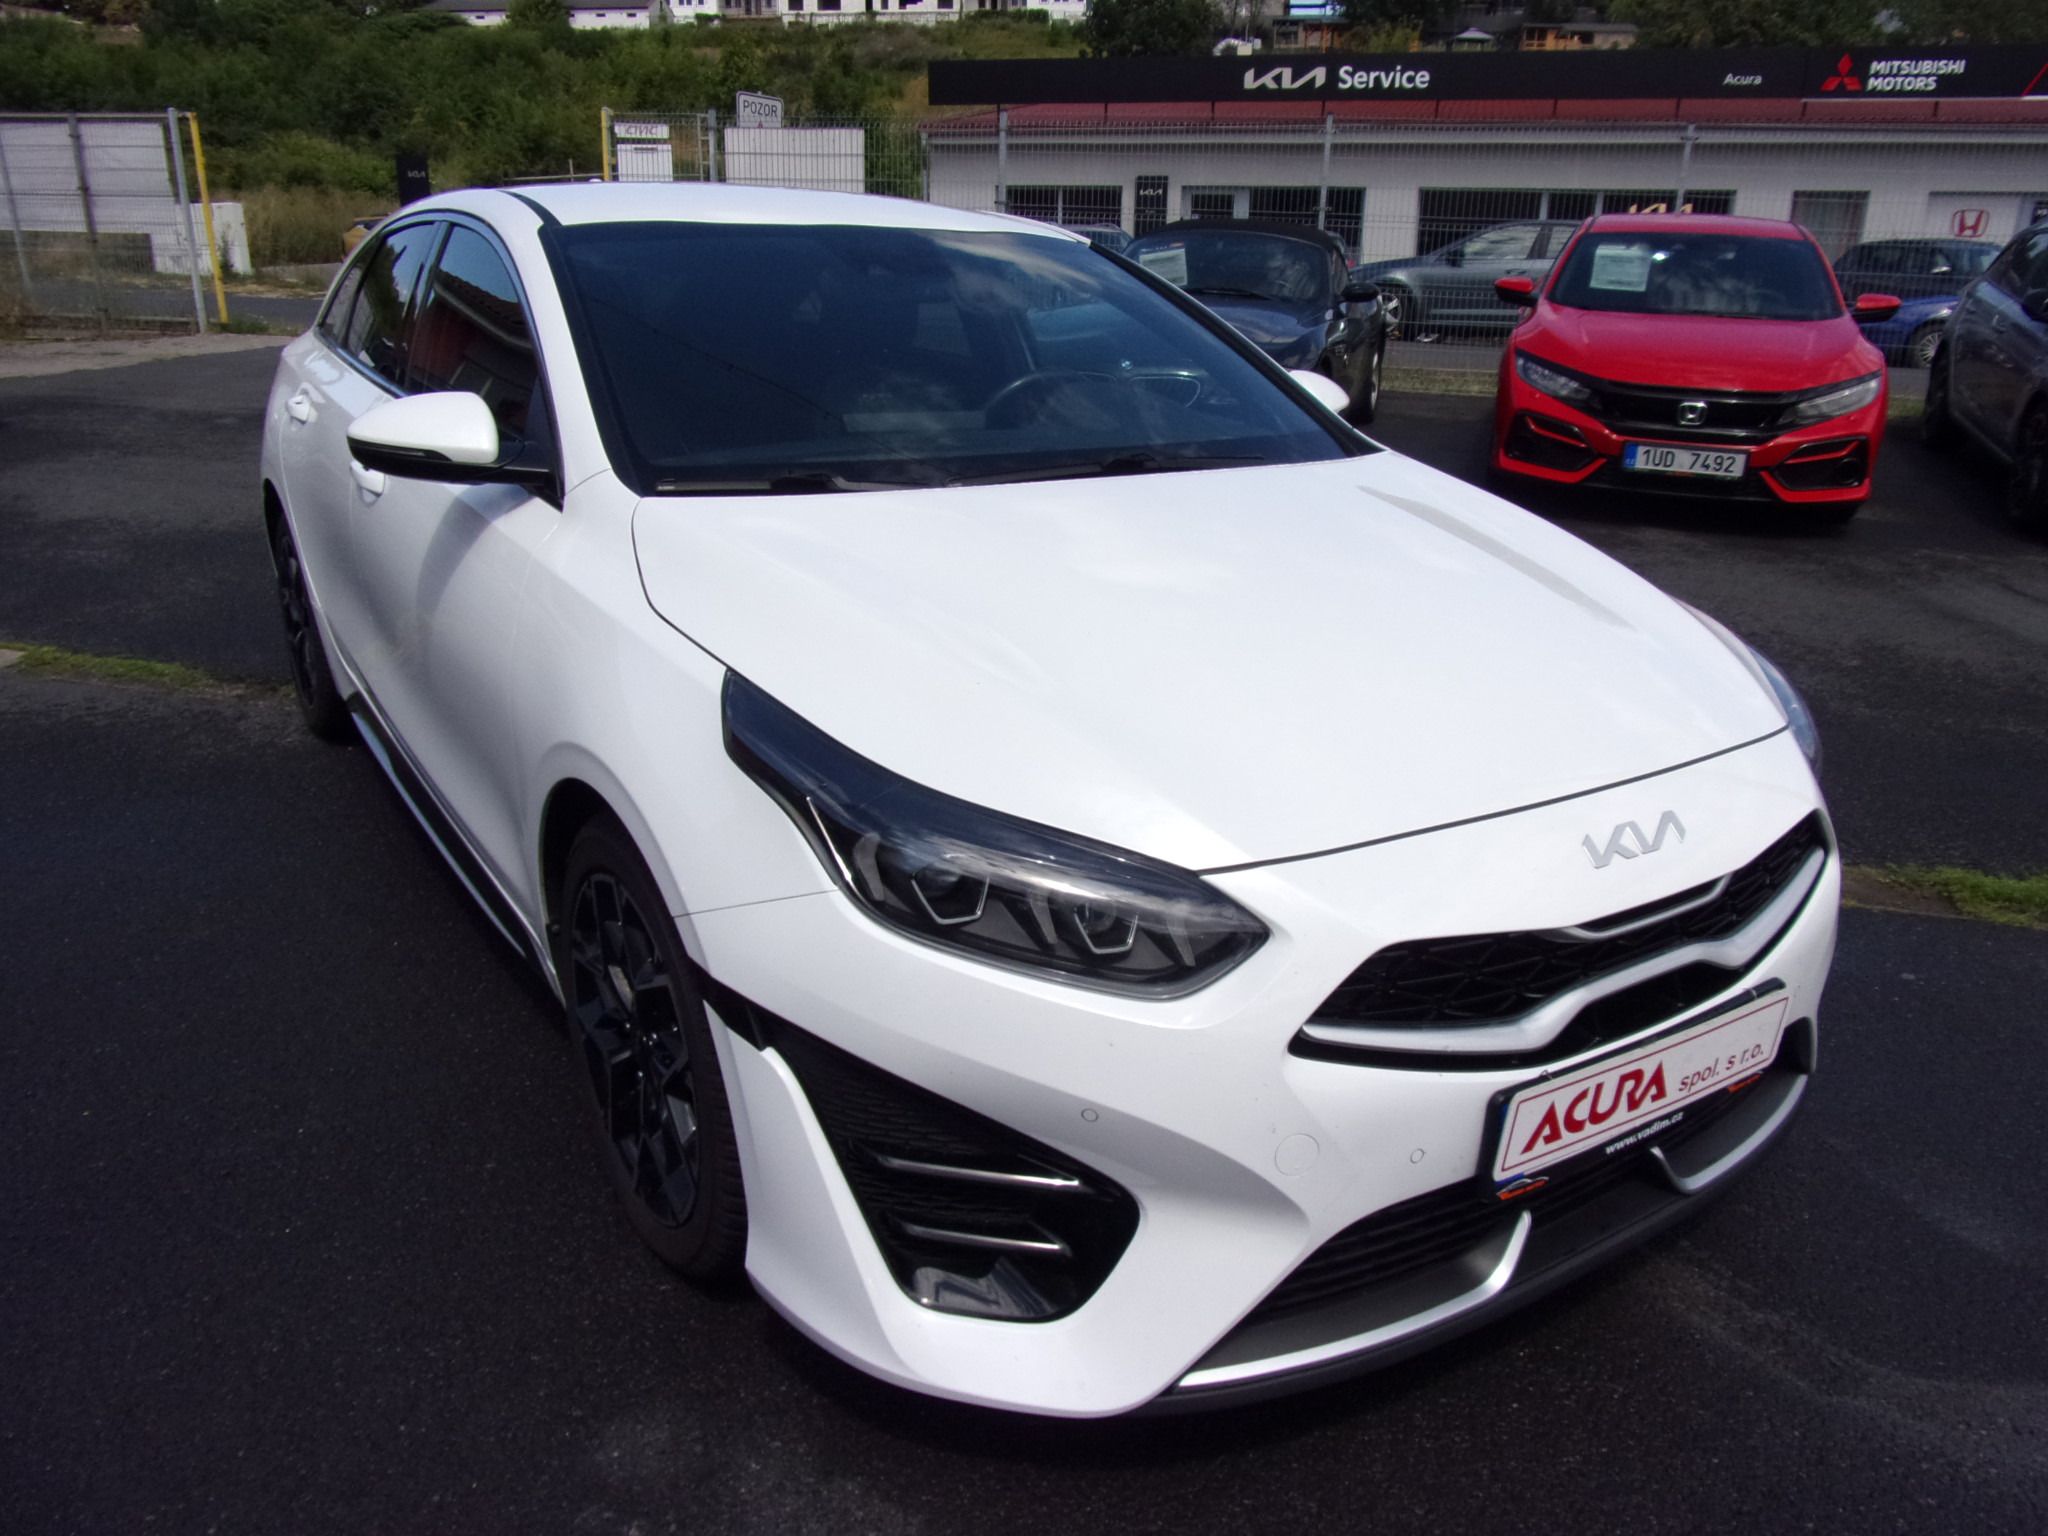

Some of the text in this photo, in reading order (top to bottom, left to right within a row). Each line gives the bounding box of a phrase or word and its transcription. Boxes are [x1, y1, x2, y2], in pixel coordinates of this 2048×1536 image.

[1243, 65, 1431, 90] KIA Service
[1869, 59, 1967, 75] MITSUBISHI
[1722, 73, 1763, 86] Acura
[1866, 76, 1938, 91] MOTORS
[743, 99, 778, 118] POZOR
[1642, 448, 1737, 474] 1UD 7492
[1582, 809, 1687, 869] KIA
[1520, 1043, 1764, 1156] ACURA spol. s r.o.
